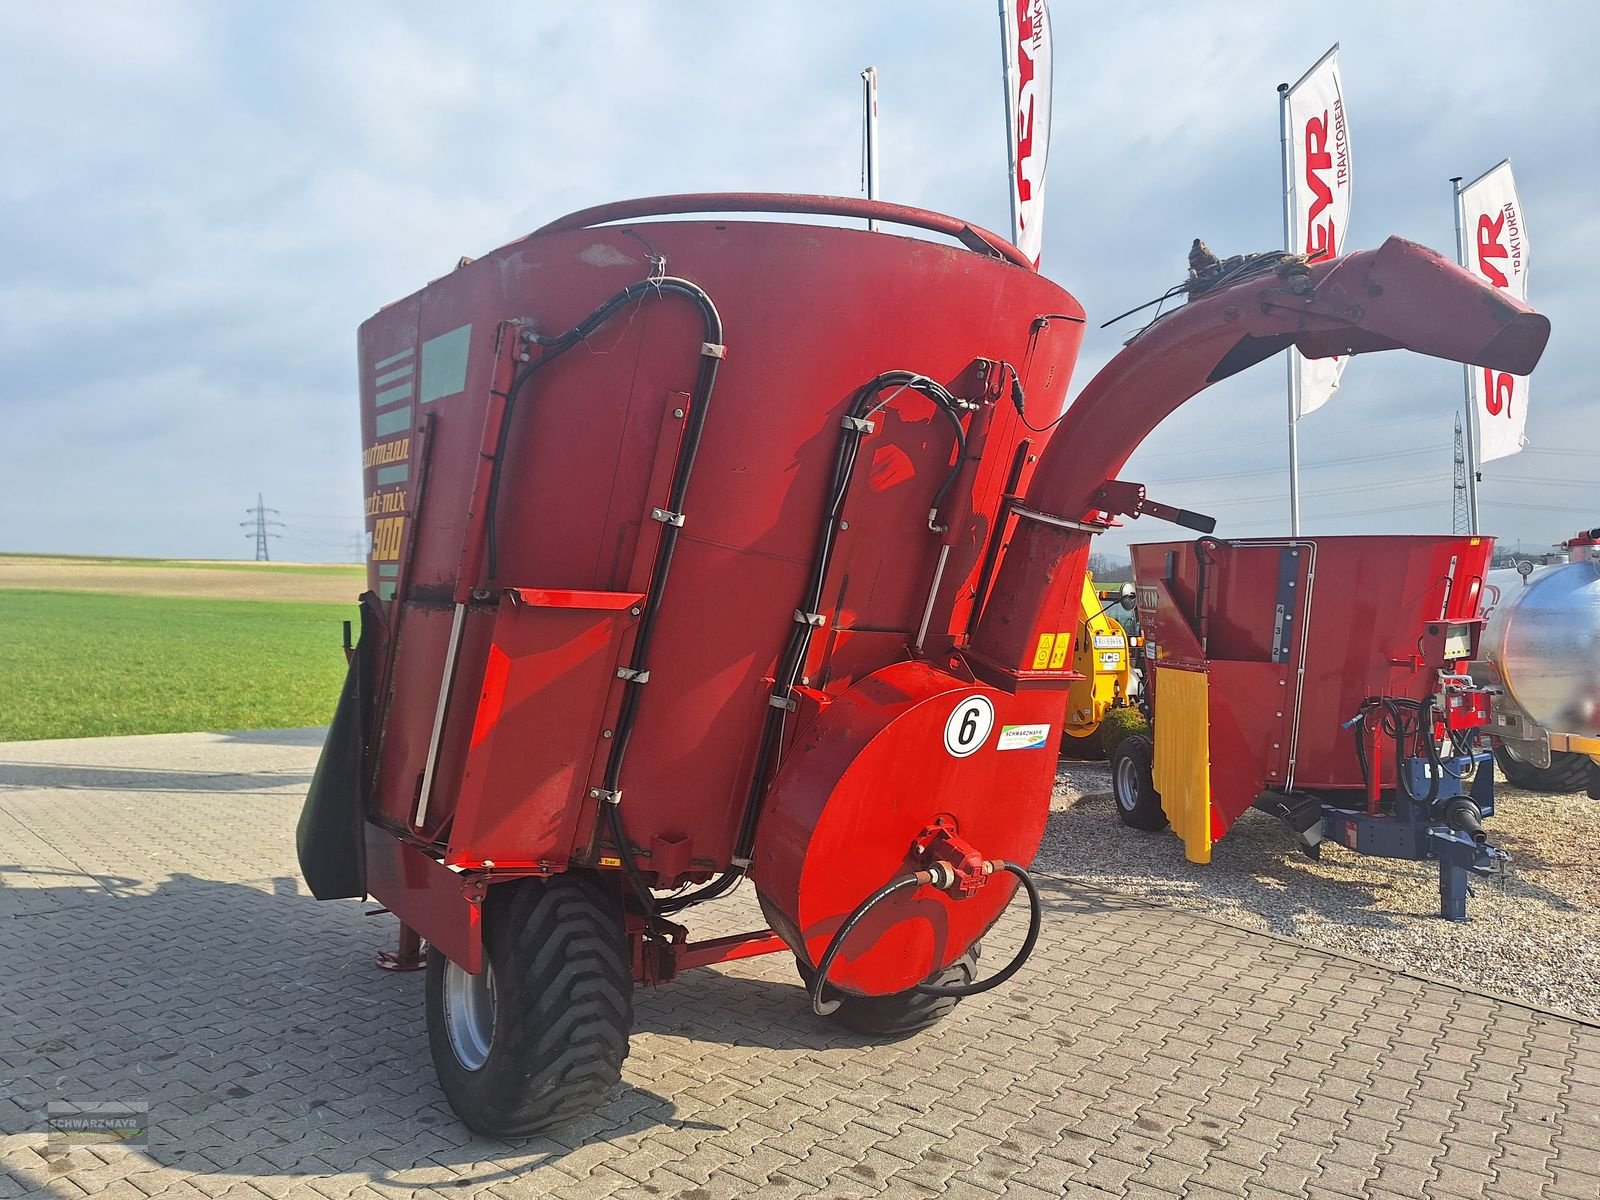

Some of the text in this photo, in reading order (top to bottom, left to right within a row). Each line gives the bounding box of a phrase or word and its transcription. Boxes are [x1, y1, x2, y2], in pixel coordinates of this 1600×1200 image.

[1333, 99, 1347, 189] TRAKTOREN
[372, 516, 405, 561] 900
[1275, 626, 1281, 635] 3
[1273, 647, 1280, 656] 2
[1099, 652, 1120, 662] JCB
[958, 707, 980, 746] 6
[1005, 729, 1043, 738] SCHWARZMAYR
